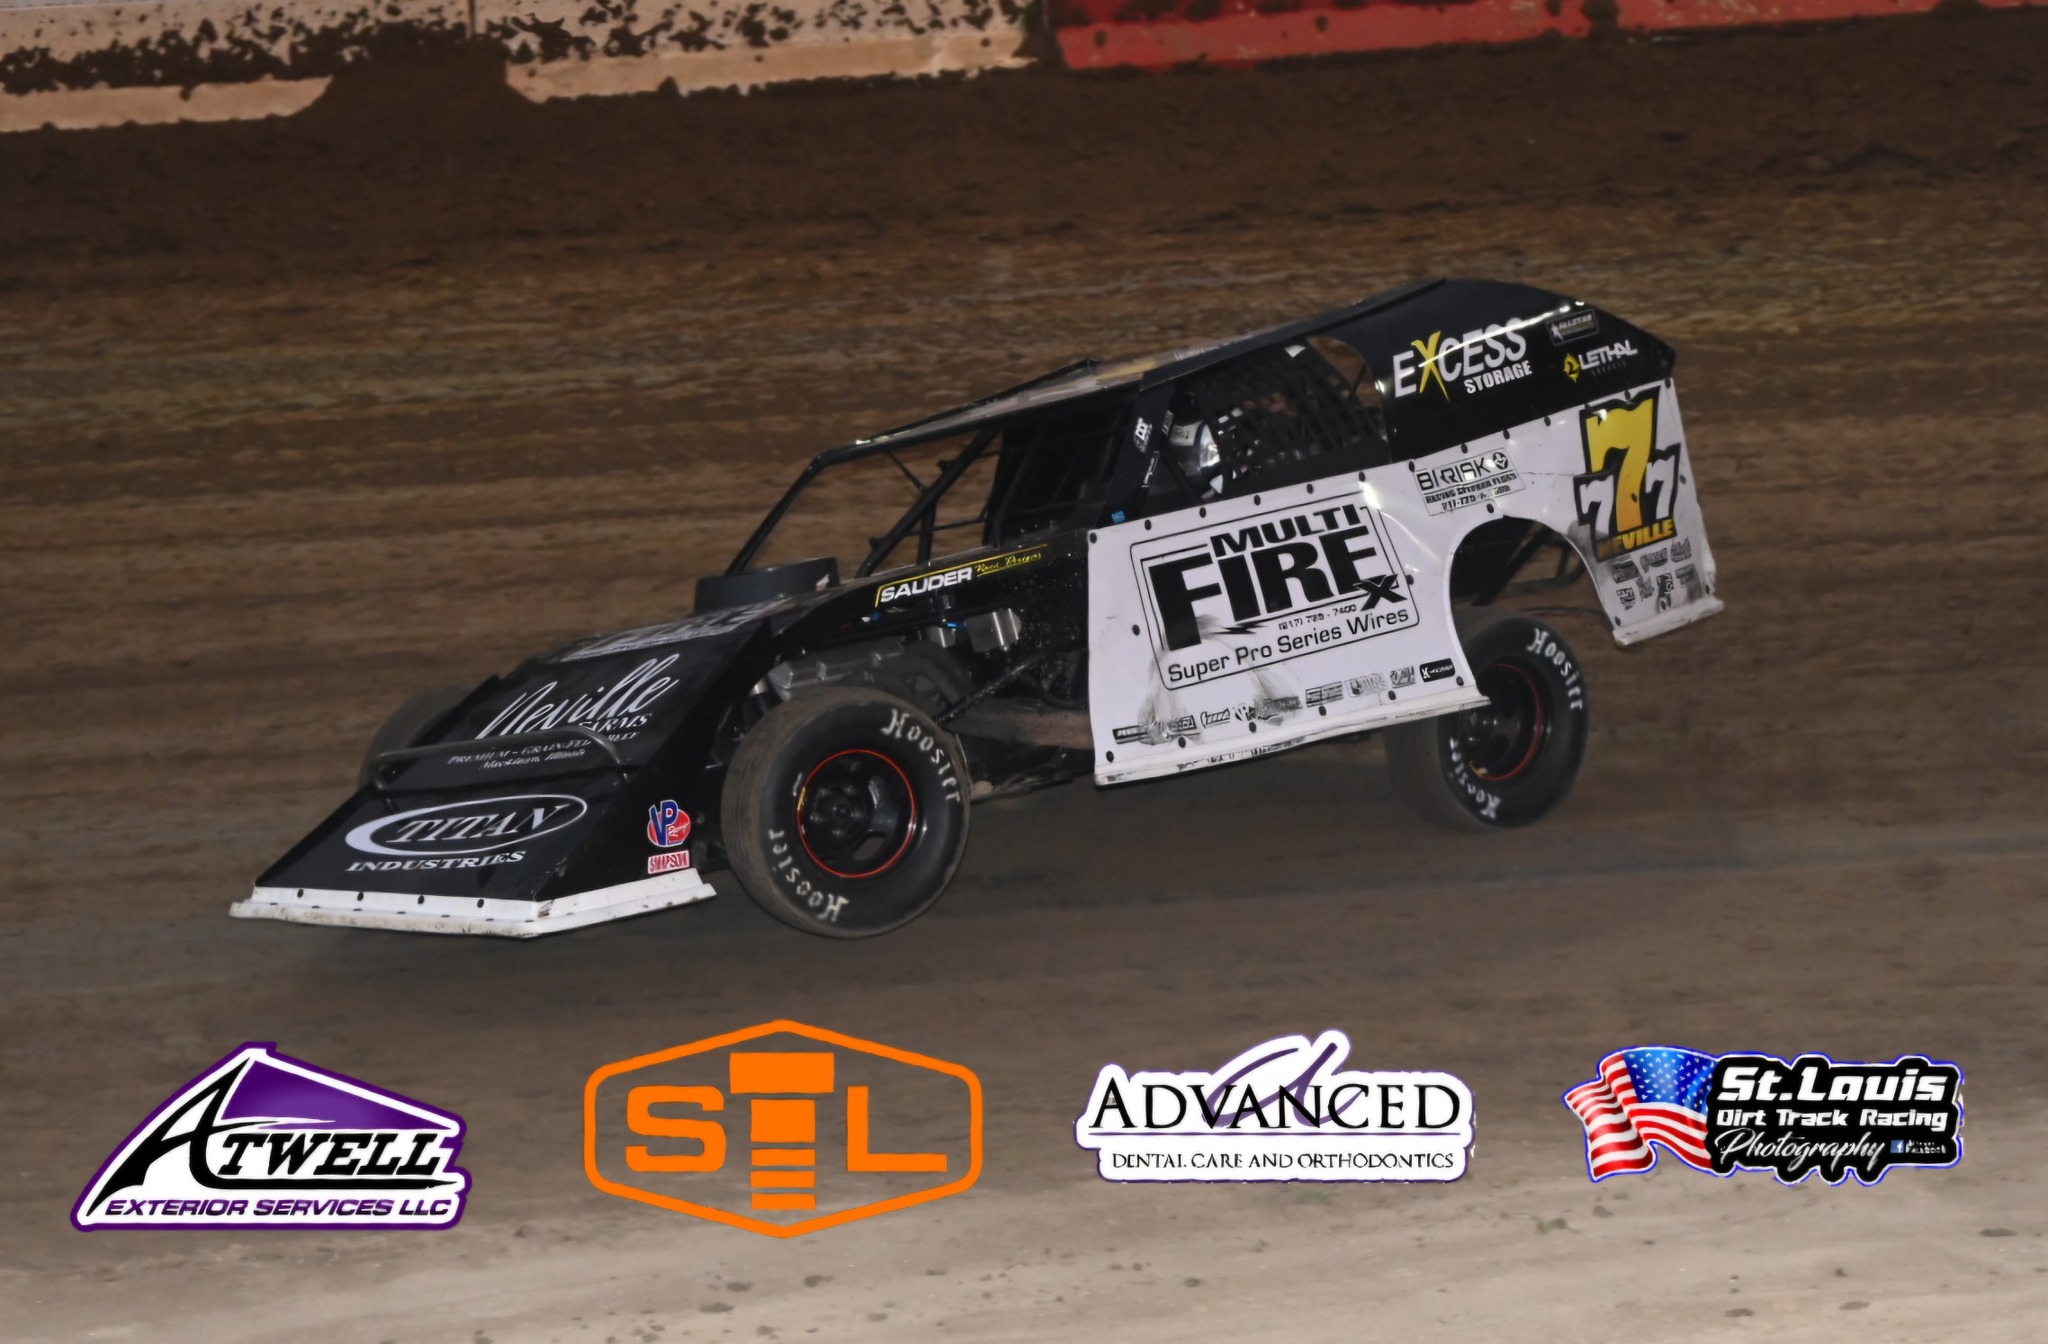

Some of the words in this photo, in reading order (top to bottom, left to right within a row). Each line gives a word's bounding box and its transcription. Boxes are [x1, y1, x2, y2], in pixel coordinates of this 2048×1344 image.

[1393, 317, 1527, 401] EXCESS
[1464, 359, 1532, 394] STORAGE
[1578, 339, 1638, 371] LETHAL
[1210, 503, 1363, 558] MULTI
[1596, 518, 1675, 561] EVILLE
[880, 566, 973, 603] SAUDER
[1148, 525, 1379, 651] FIRE
[1167, 652, 1231, 683] Super
[1235, 645, 1273, 667] Pro
[1277, 627, 1343, 654] Series
[1346, 606, 1410, 635] Wires
[1526, 628, 1583, 711] Hoosier
[475, 653, 680, 740] Neville
[881, 707, 962, 803] Hoosier
[385, 802, 572, 844] TITAN
[648, 799, 679, 847] VP
[345, 850, 527, 872] INDUSTRIES
